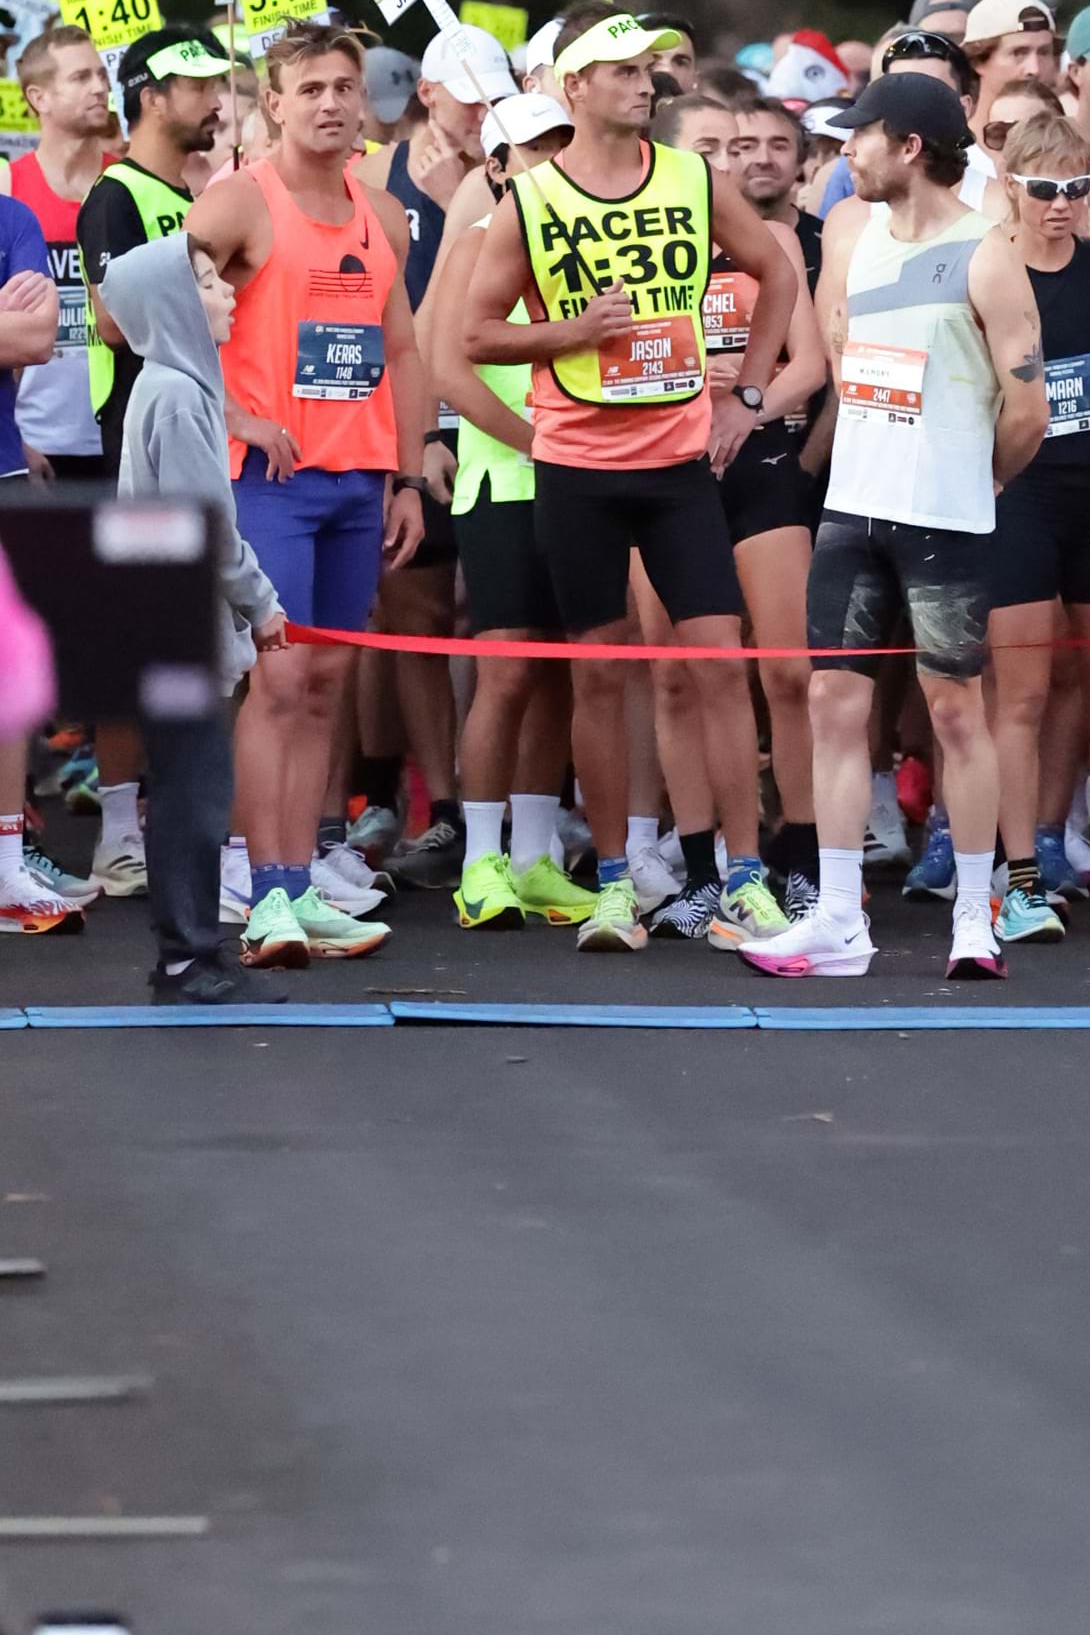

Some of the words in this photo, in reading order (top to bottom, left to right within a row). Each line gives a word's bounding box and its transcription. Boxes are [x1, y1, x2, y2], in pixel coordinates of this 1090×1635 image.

[541, 206, 697, 253] PACER
[548, 239, 698, 294] 1:30
[326, 343, 362, 365] KERAS
[629, 337, 673, 362] JASON
[335, 366, 354, 380] 1148
[642, 361, 664, 376] 2143
[872, 387, 892, 403] 2447
[1045, 376, 1084, 402] MARN
[1057, 399, 1078, 415] 1216
